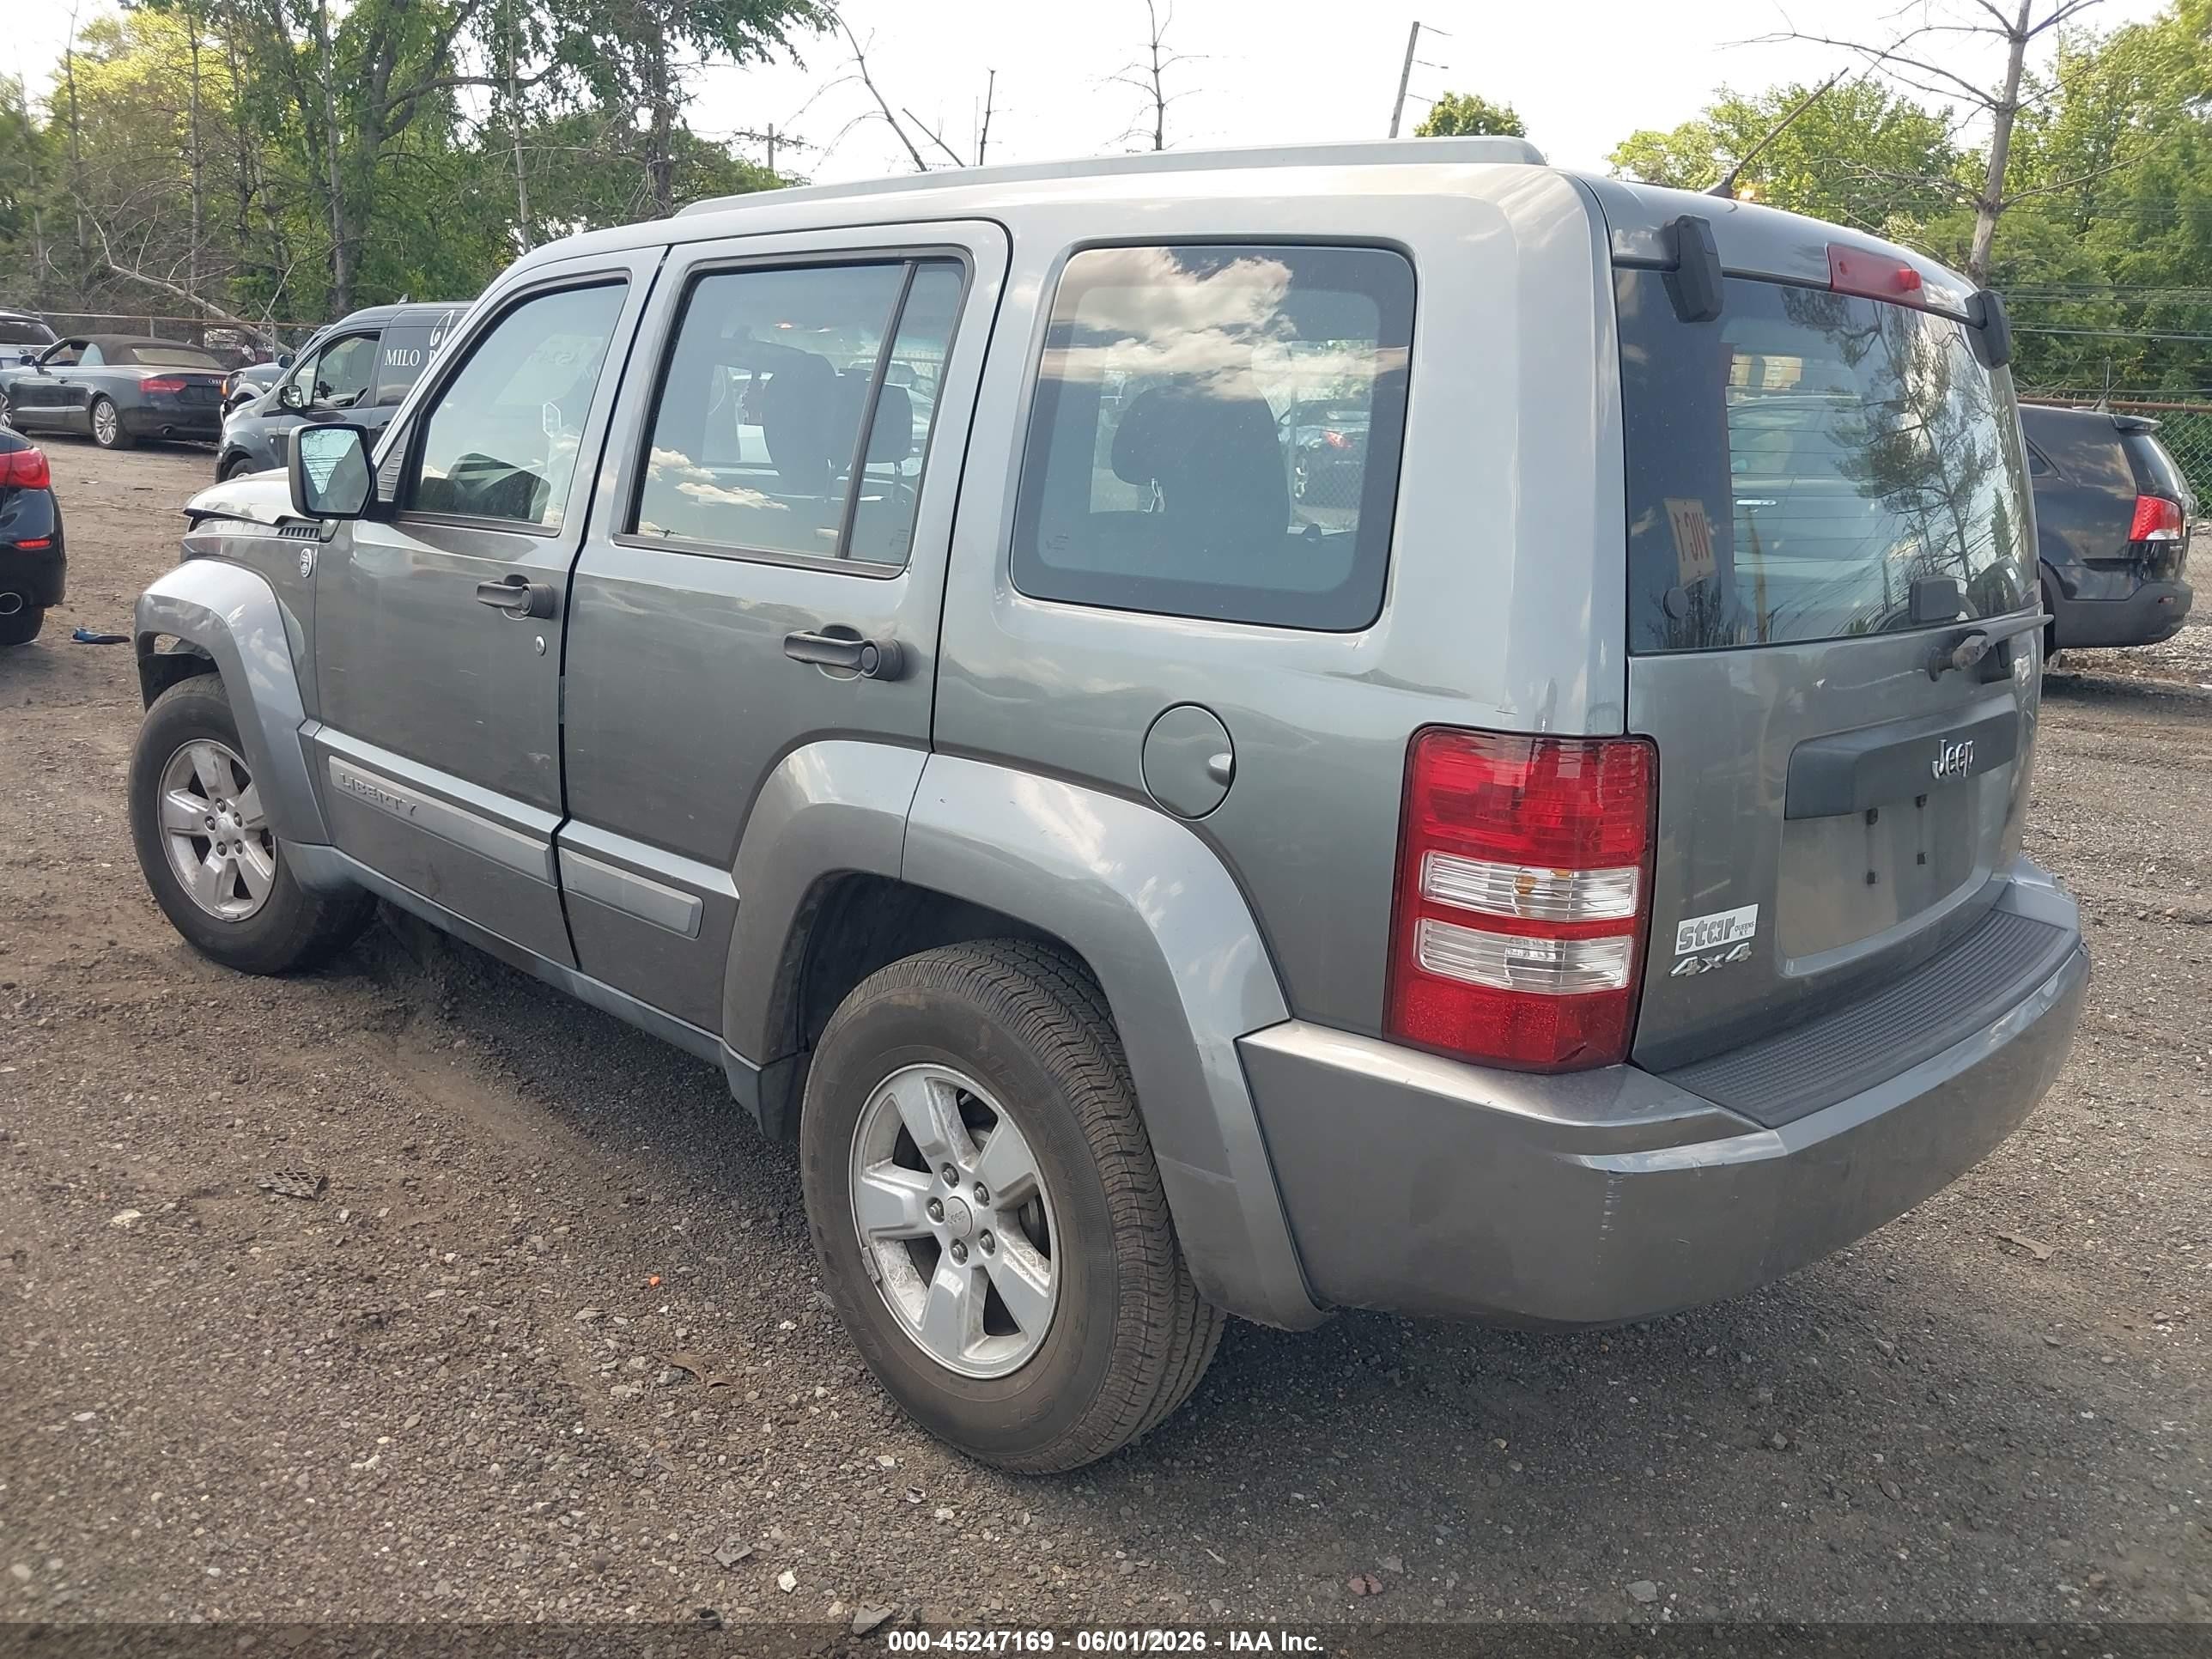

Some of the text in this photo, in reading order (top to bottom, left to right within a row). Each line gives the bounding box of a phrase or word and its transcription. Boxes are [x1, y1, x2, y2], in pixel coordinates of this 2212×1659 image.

[384, 349, 421, 367] MILO
[1931, 738, 1974, 780] Jeep
[339, 772, 418, 817] LIBERTY
[1678, 915, 1736, 951] star
[1734, 921, 1755, 933] QUEENS
